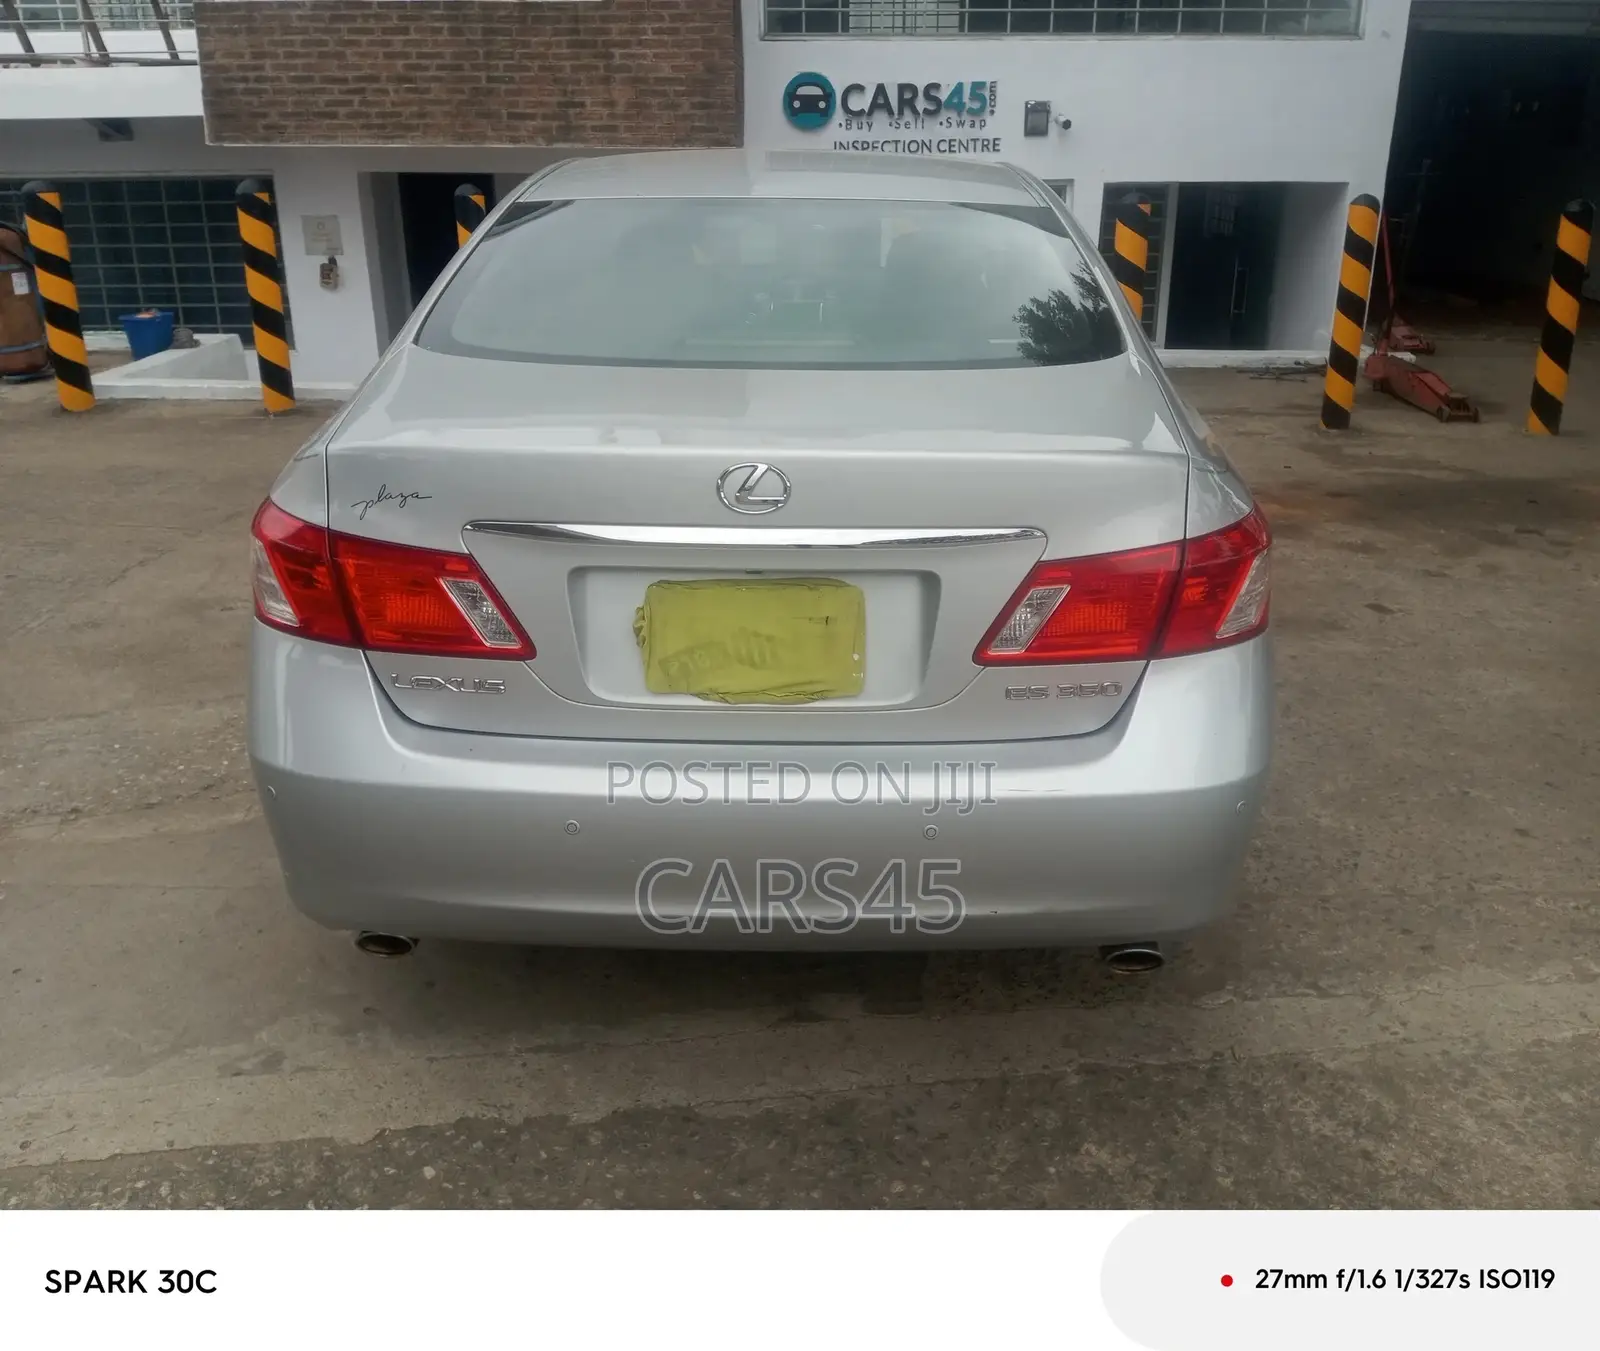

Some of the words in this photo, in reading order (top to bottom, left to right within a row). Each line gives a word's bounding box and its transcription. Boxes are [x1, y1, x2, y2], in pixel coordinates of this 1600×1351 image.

[841, 81, 987, 118] CARS45
[945, 117, 987, 130] Swap
[936, 138, 1002, 153] CENTRE
[351, 483, 432, 520] plaza
[390, 672, 506, 694] LEXUS
[1005, 684, 1050, 700] ES
[1056, 681, 1123, 699] 350
